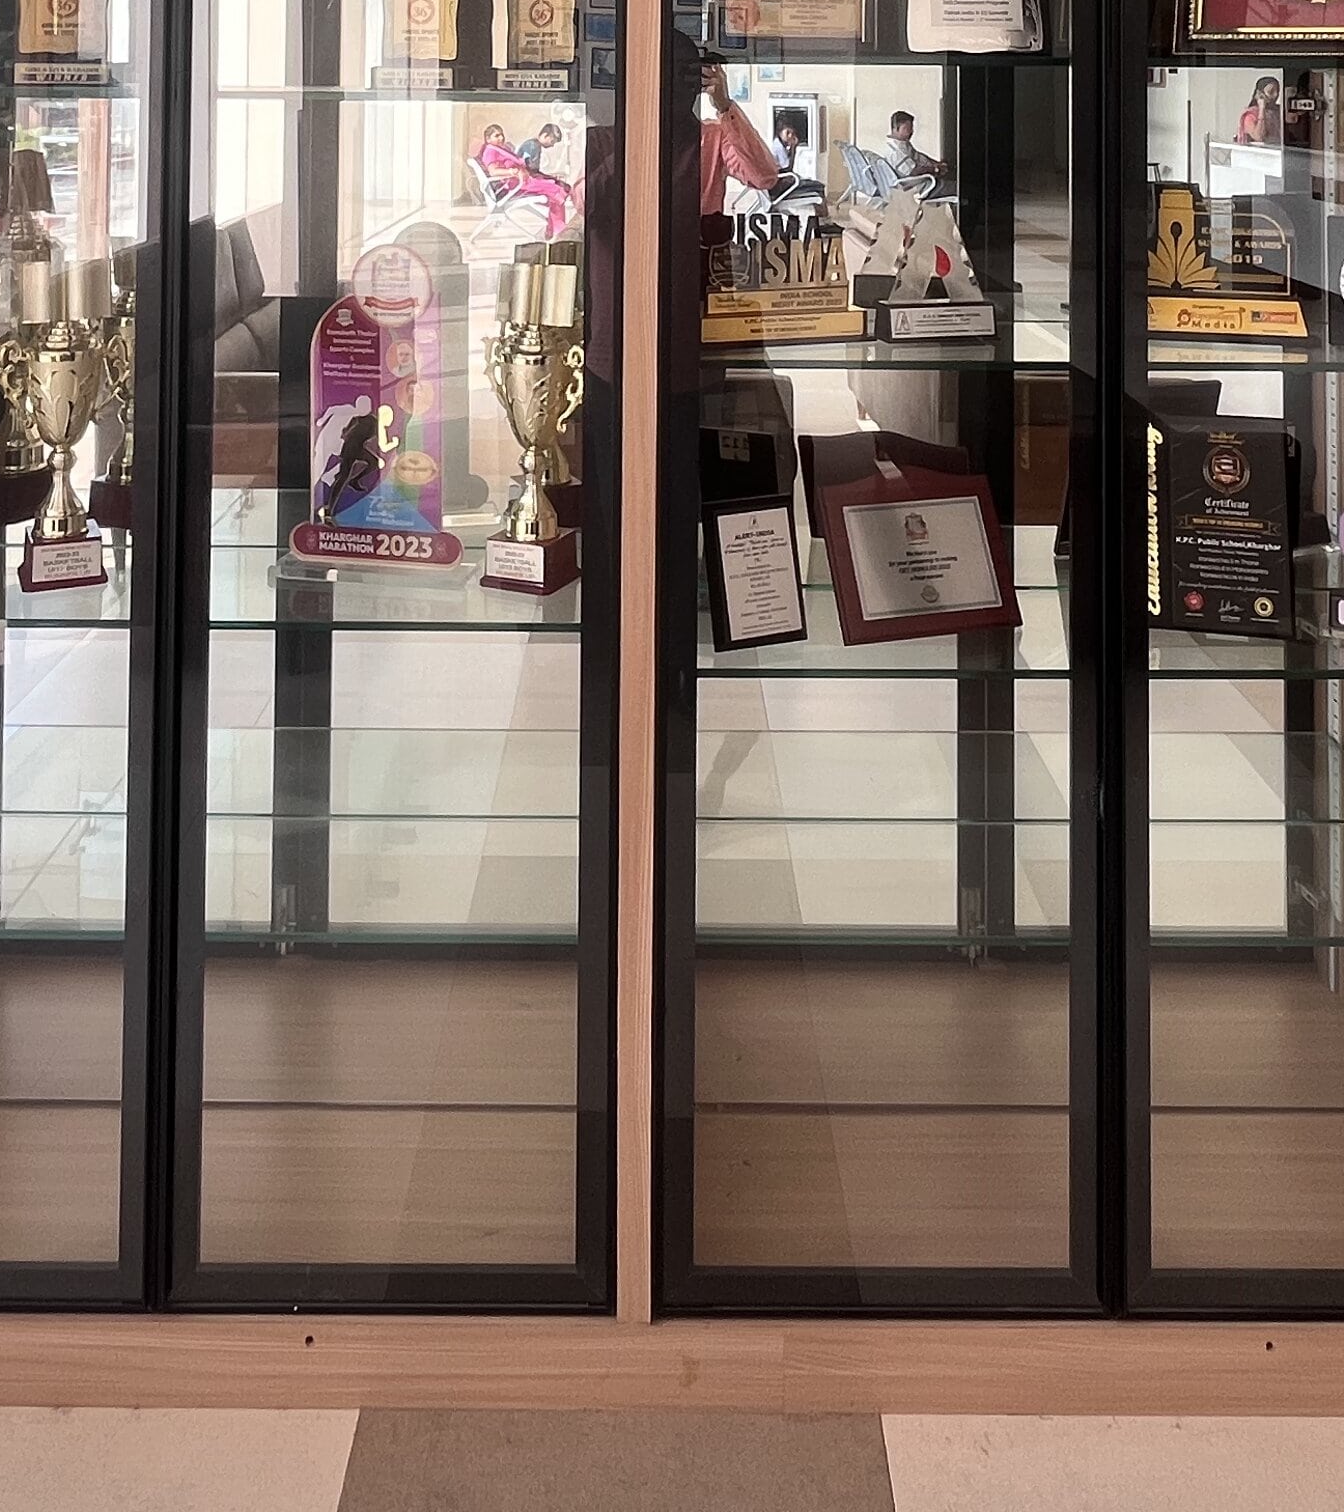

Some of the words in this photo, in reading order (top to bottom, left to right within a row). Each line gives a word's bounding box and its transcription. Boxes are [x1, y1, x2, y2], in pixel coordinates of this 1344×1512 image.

[512, 79, 552, 88] WINNER
[750, 238, 848, 287] ISMA
[796, 299, 824, 307] AWARD
[1191, 319, 1235, 329] Media
[1204, 496, 1250, 509] Certificate
[319, 531, 373, 544] KHARGHAR
[1197, 538, 1219, 546] Public
[319, 541, 374, 553] MARATHON
[375, 533, 433, 558] 2023
[43, 557, 93, 567] BASKETBALL
[66, 564, 89, 572] BOYS
